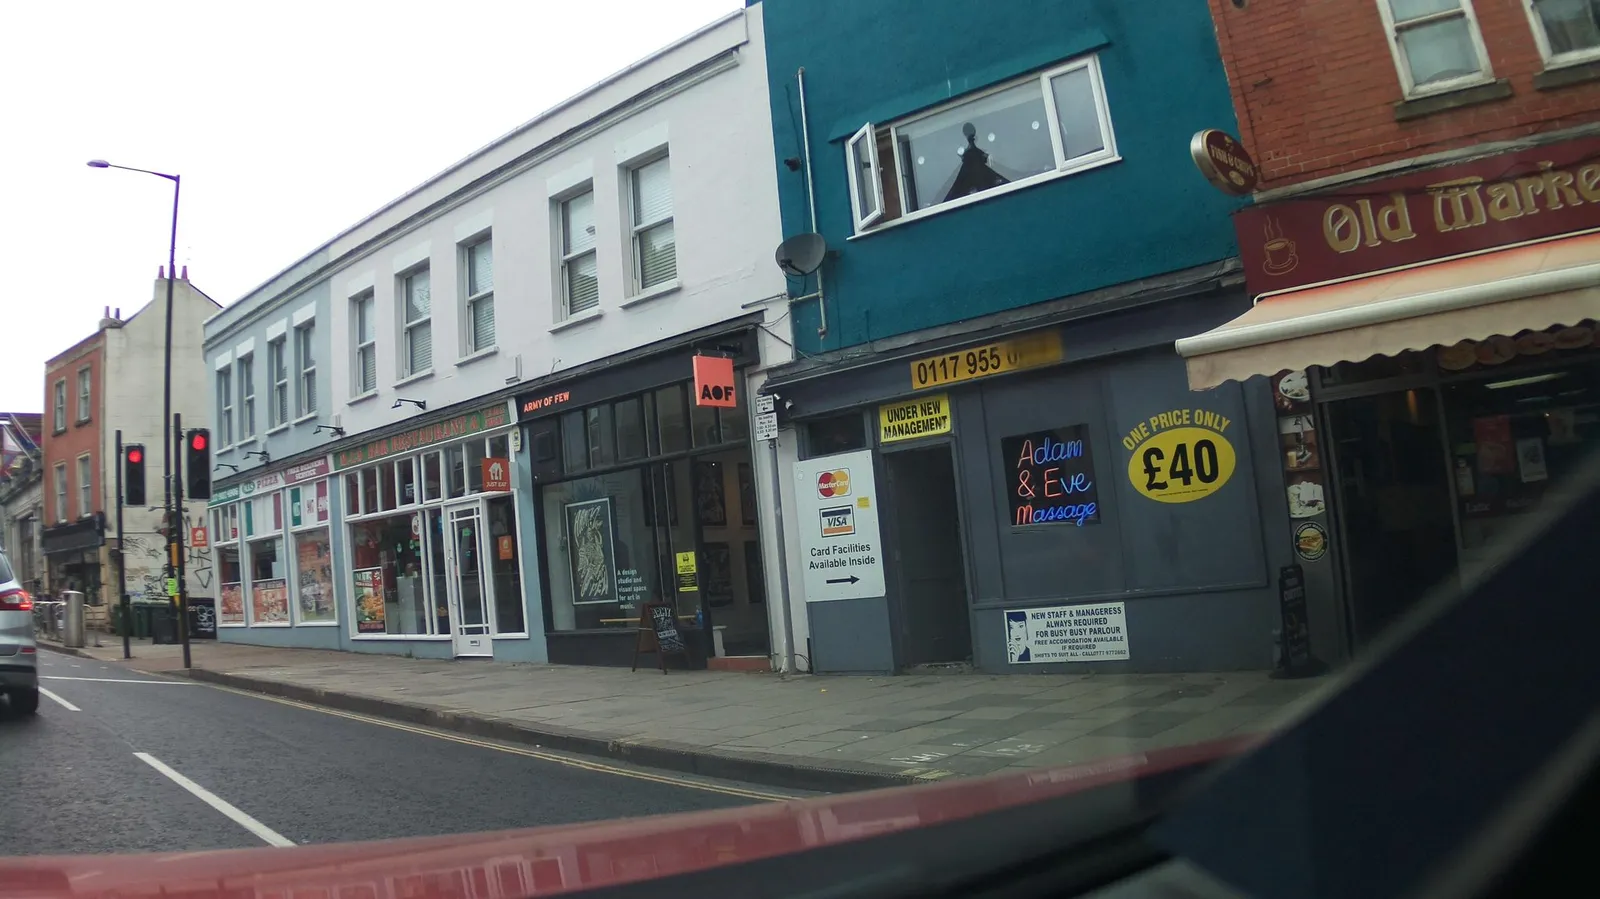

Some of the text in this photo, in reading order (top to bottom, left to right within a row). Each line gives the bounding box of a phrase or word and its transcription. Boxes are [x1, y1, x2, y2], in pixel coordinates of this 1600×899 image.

[1323, 193, 1417, 253] Old
[917, 355, 959, 385] 0117
[966, 346, 1001, 375] 955
[523, 391, 570, 413] ARMY OF FEW
[701, 384, 734, 401] AOF
[887, 400, 941, 423] UNDER NEW
[391, 419, 467, 452] RESTAURANT
[470, 416, 478, 429] &
[884, 415, 947, 439] MANAGEMENT
[1122, 409, 1231, 451] ONE PRICE ONLY
[1017, 437, 1082, 469] Adam
[1142, 439, 1219, 491] £40
[256, 474, 279, 489] PIZZA
[819, 480, 849, 489] MasterCard
[1017, 467, 1092, 498] & Eve
[827, 516, 847, 527] VISA
[1016, 502, 1097, 527] Massage
[810, 542, 871, 557] Card Facilities
[809, 555, 876, 570] Available Inside
[1031, 606, 1122, 620] NEW STAFF & MANAGERESS
[1046, 617, 1107, 628] ALWAYS REQUIRED
[1036, 626, 1121, 638] FOR BUSY BUSY PARLOUR
[1093, 635, 1124, 643] AVAILABLE
